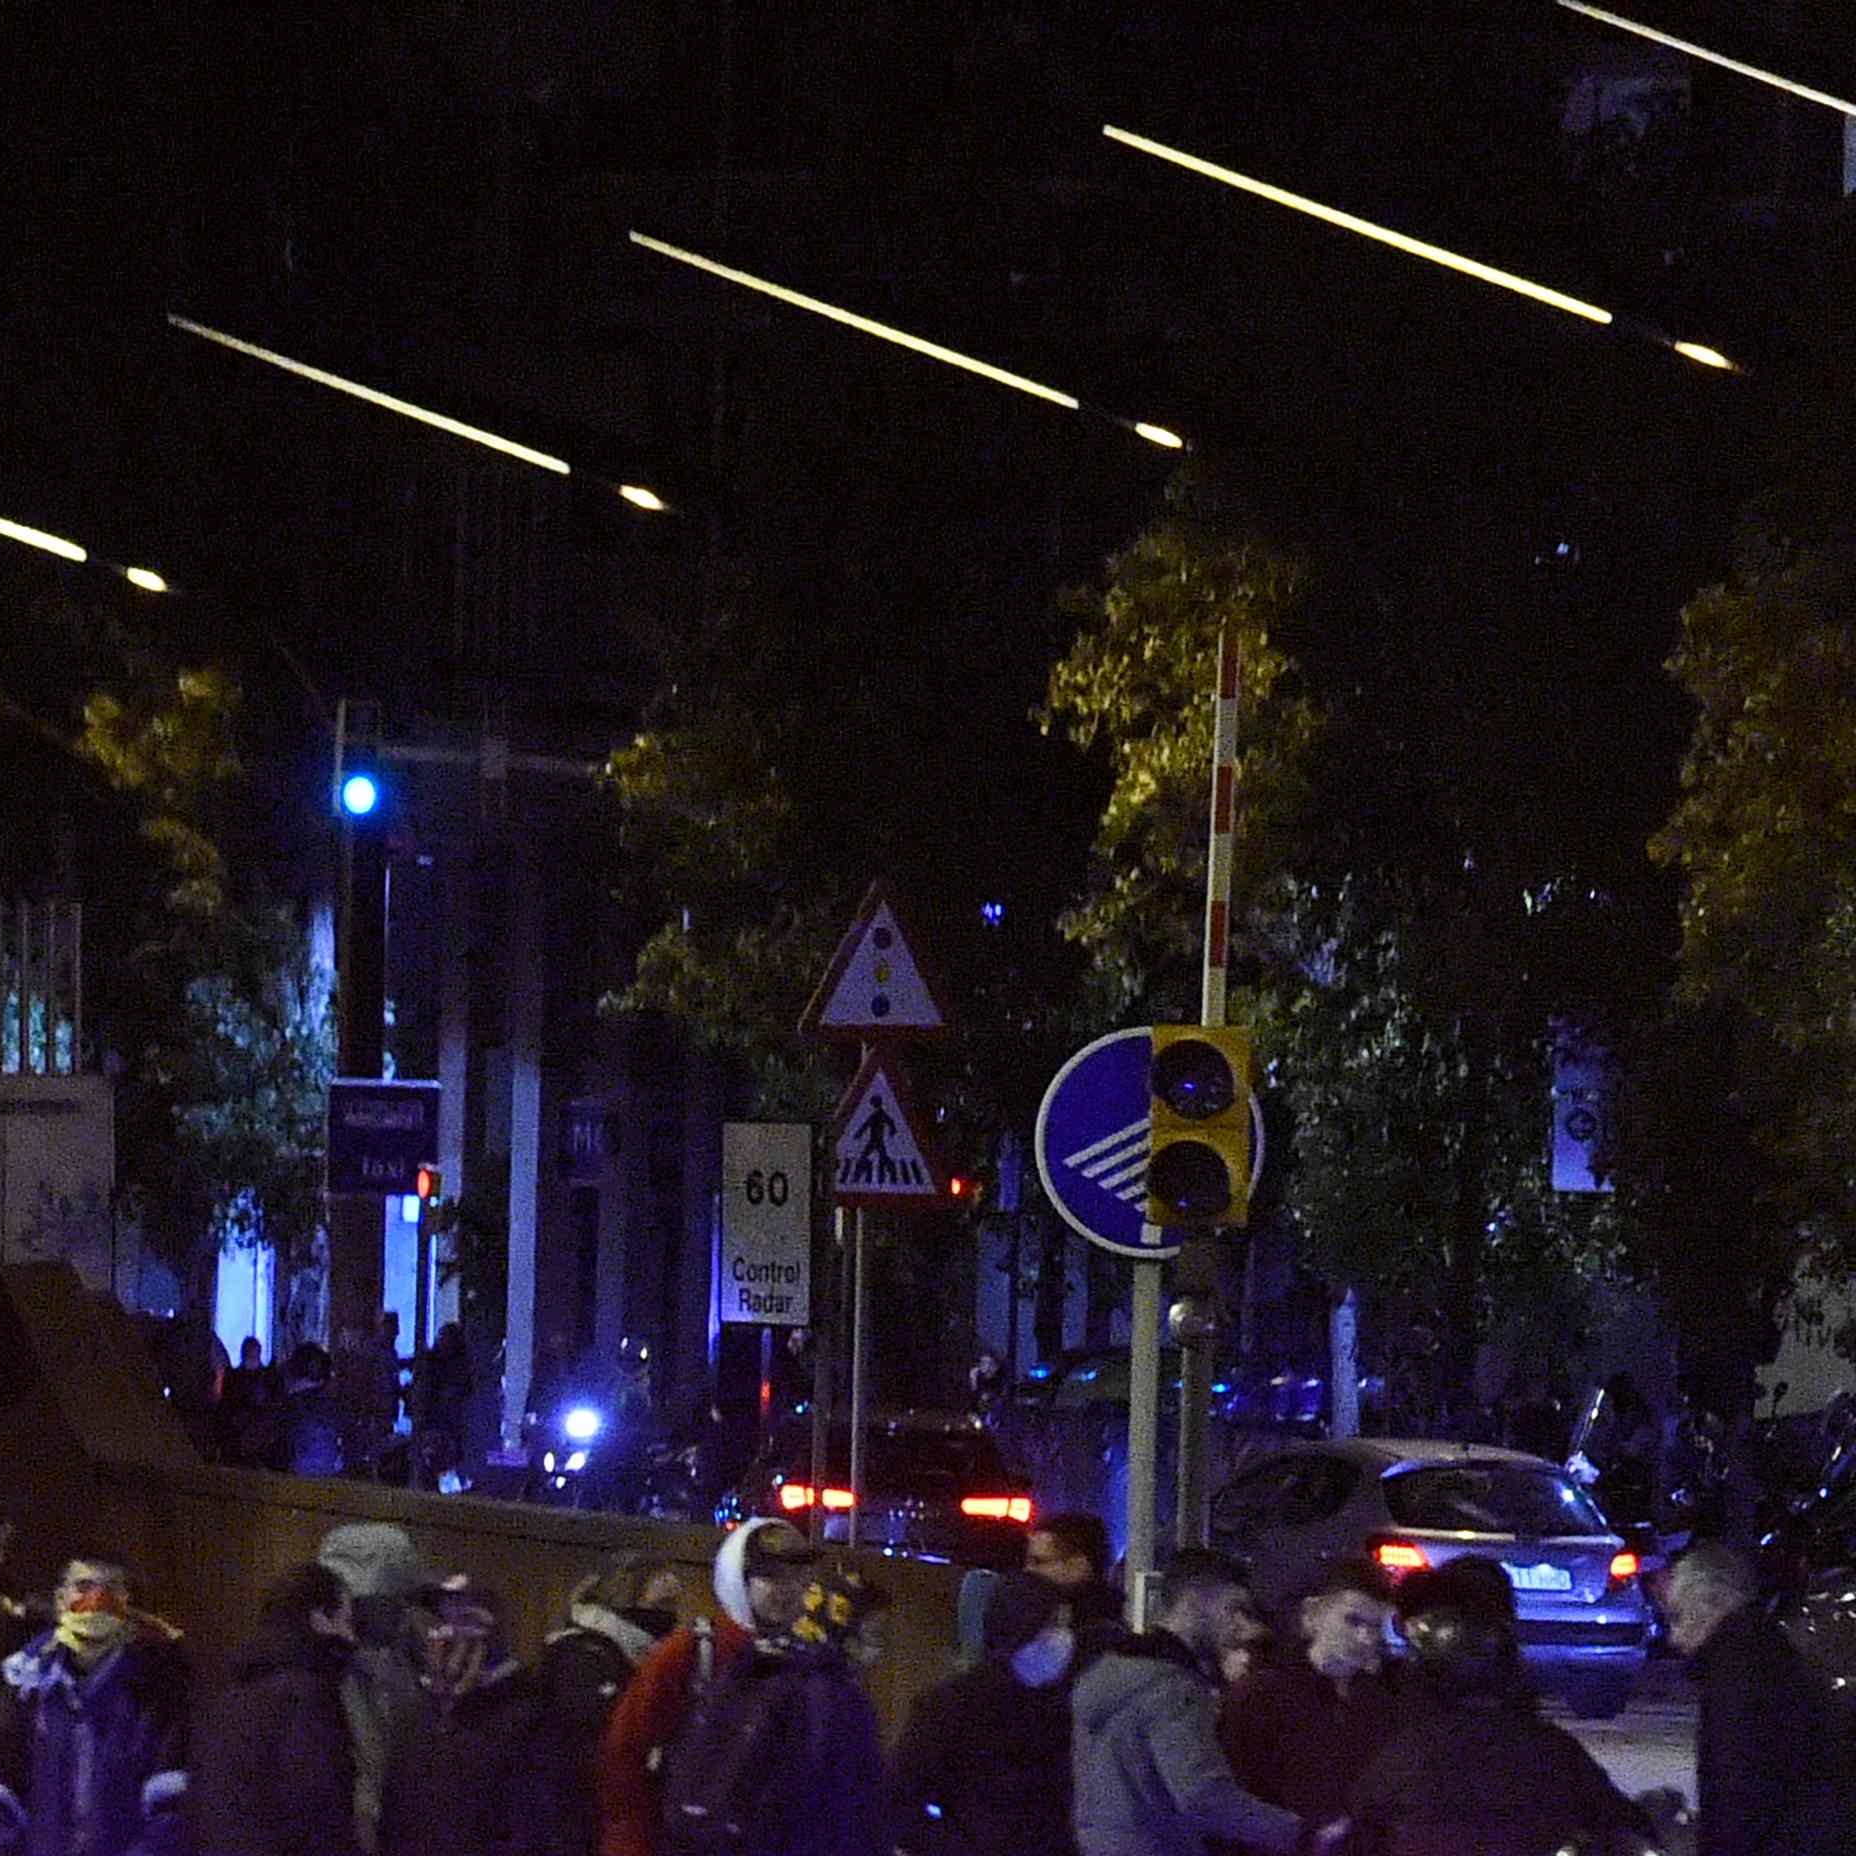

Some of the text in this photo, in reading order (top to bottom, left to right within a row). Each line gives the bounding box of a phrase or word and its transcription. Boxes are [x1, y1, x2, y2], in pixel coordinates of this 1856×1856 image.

[745, 1169, 788, 1207] 60
[733, 1257, 800, 1284] Control
[739, 1289, 794, 1314] Radar
